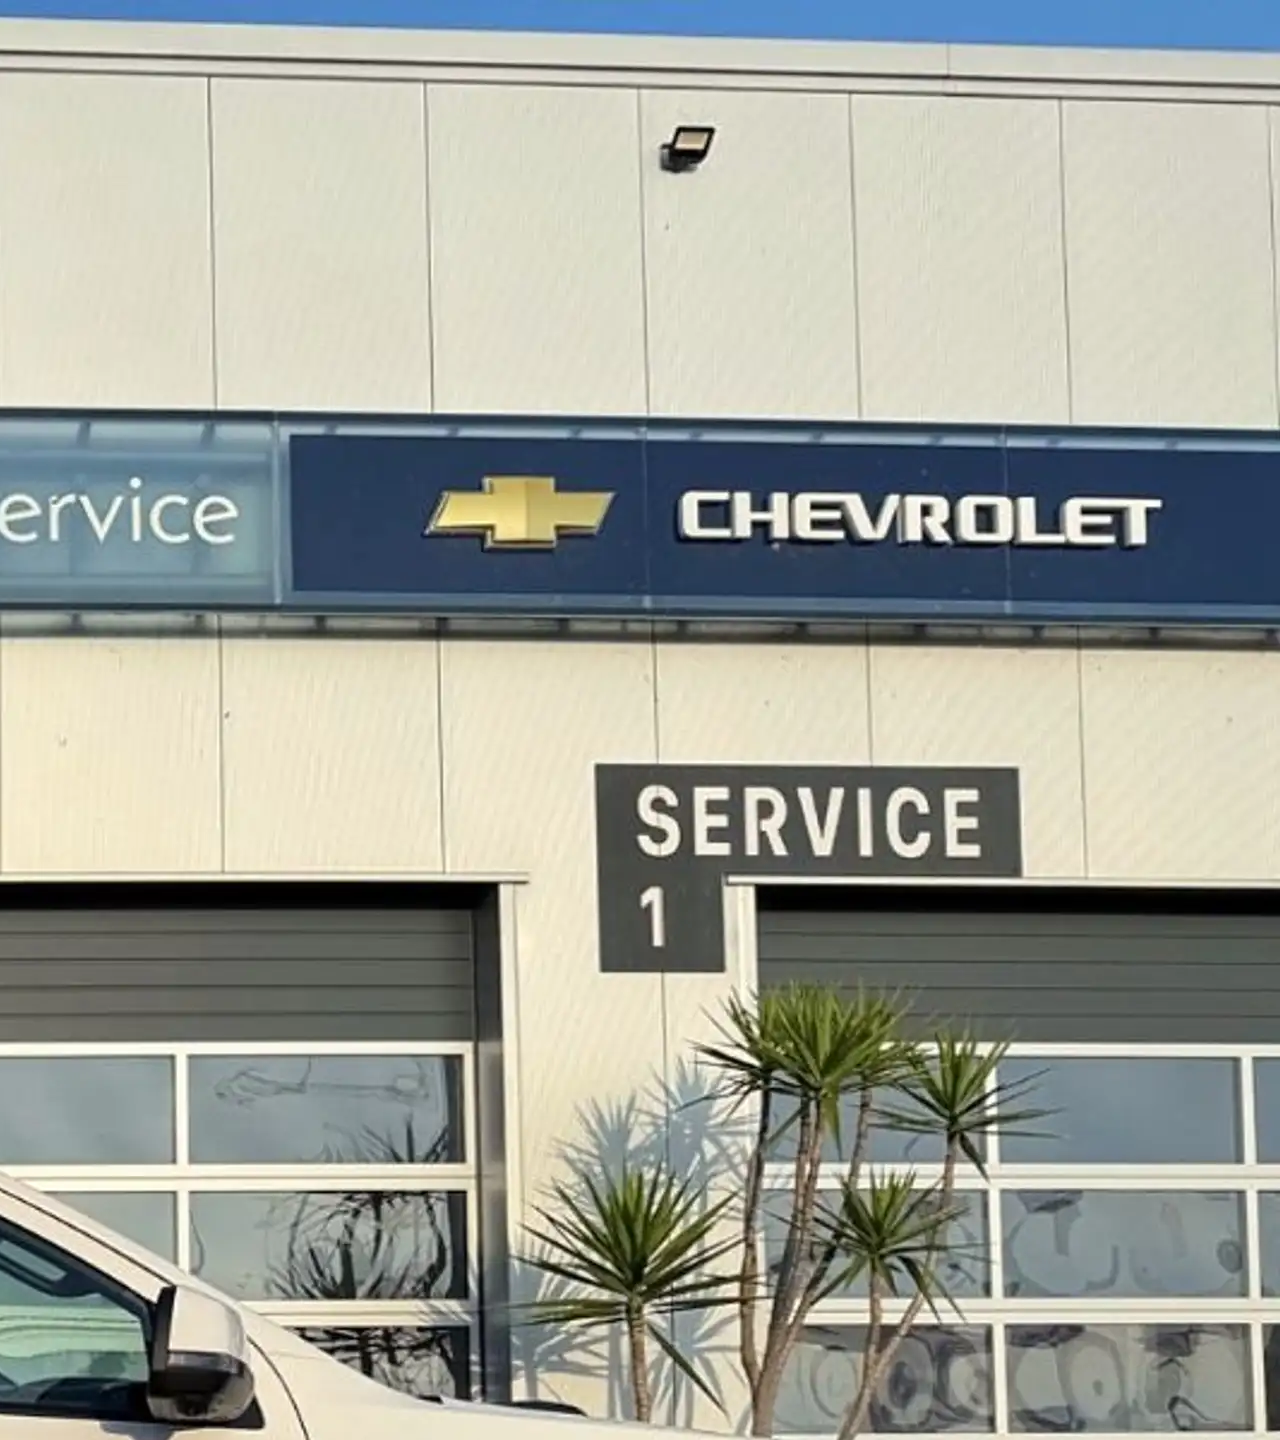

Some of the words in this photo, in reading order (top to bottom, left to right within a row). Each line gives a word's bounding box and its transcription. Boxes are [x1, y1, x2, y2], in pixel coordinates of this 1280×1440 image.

[680, 491, 1164, 547] CHEVROLET
[636, 785, 982, 859] SERVICE
[639, 885, 665, 948] 1
